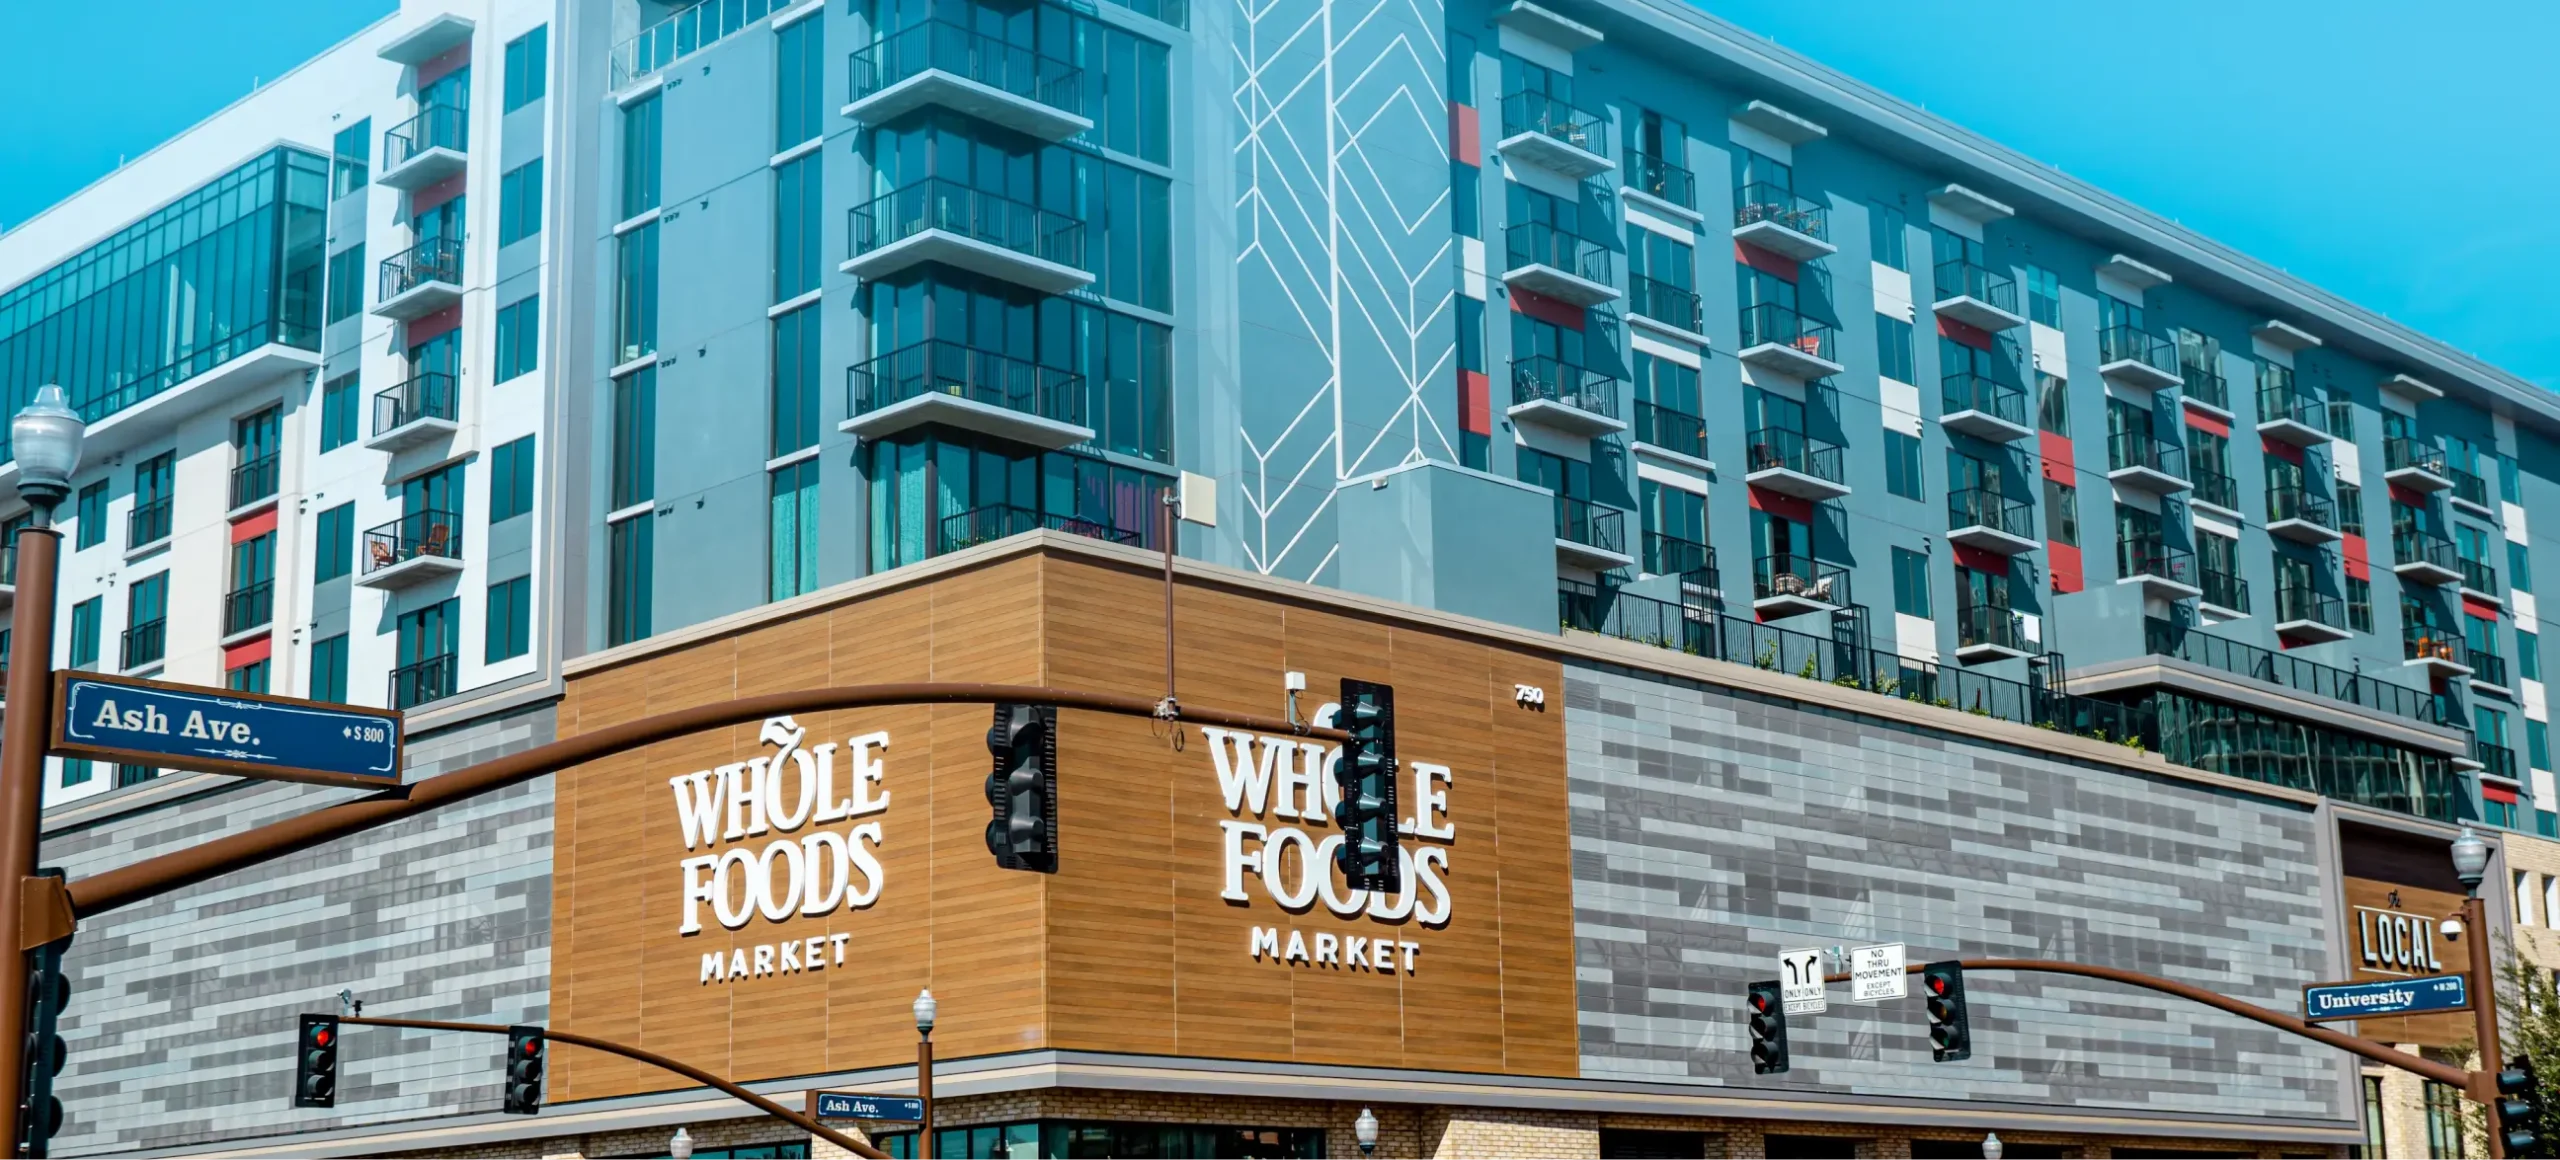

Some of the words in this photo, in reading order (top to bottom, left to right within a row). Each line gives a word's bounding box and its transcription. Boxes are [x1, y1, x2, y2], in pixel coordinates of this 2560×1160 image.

[1514, 684, 1544, 704] 750
[92, 699, 170, 735] Ash
[179, 709, 261, 746] Ave.
[353, 725, 362, 740] S
[363, 726, 384, 743] 800
[1202, 703, 1455, 840] WHE
[669, 715, 890, 851] WHOLE
[679, 822, 884, 935] FOODS
[1251, 926, 1420, 973] MARKET
[2359, 910, 2442, 970] LOCAL
[700, 932, 850, 984] MARKET
[1867, 959, 1889, 968] THRU
[1871, 949, 1884, 958] NO
[1855, 967, 1902, 979] MOVEMENT
[1785, 989, 1801, 998] ONLY
[1804, 987, 1821, 996] ONLY
[1863, 988, 1895, 997] BICYCLES
[1866, 981, 1891, 989] EXCEPT
[2318, 988, 2415, 1009] University
[826, 1100, 850, 1112] Ash
[852, 1101, 879, 1113] Ave.
